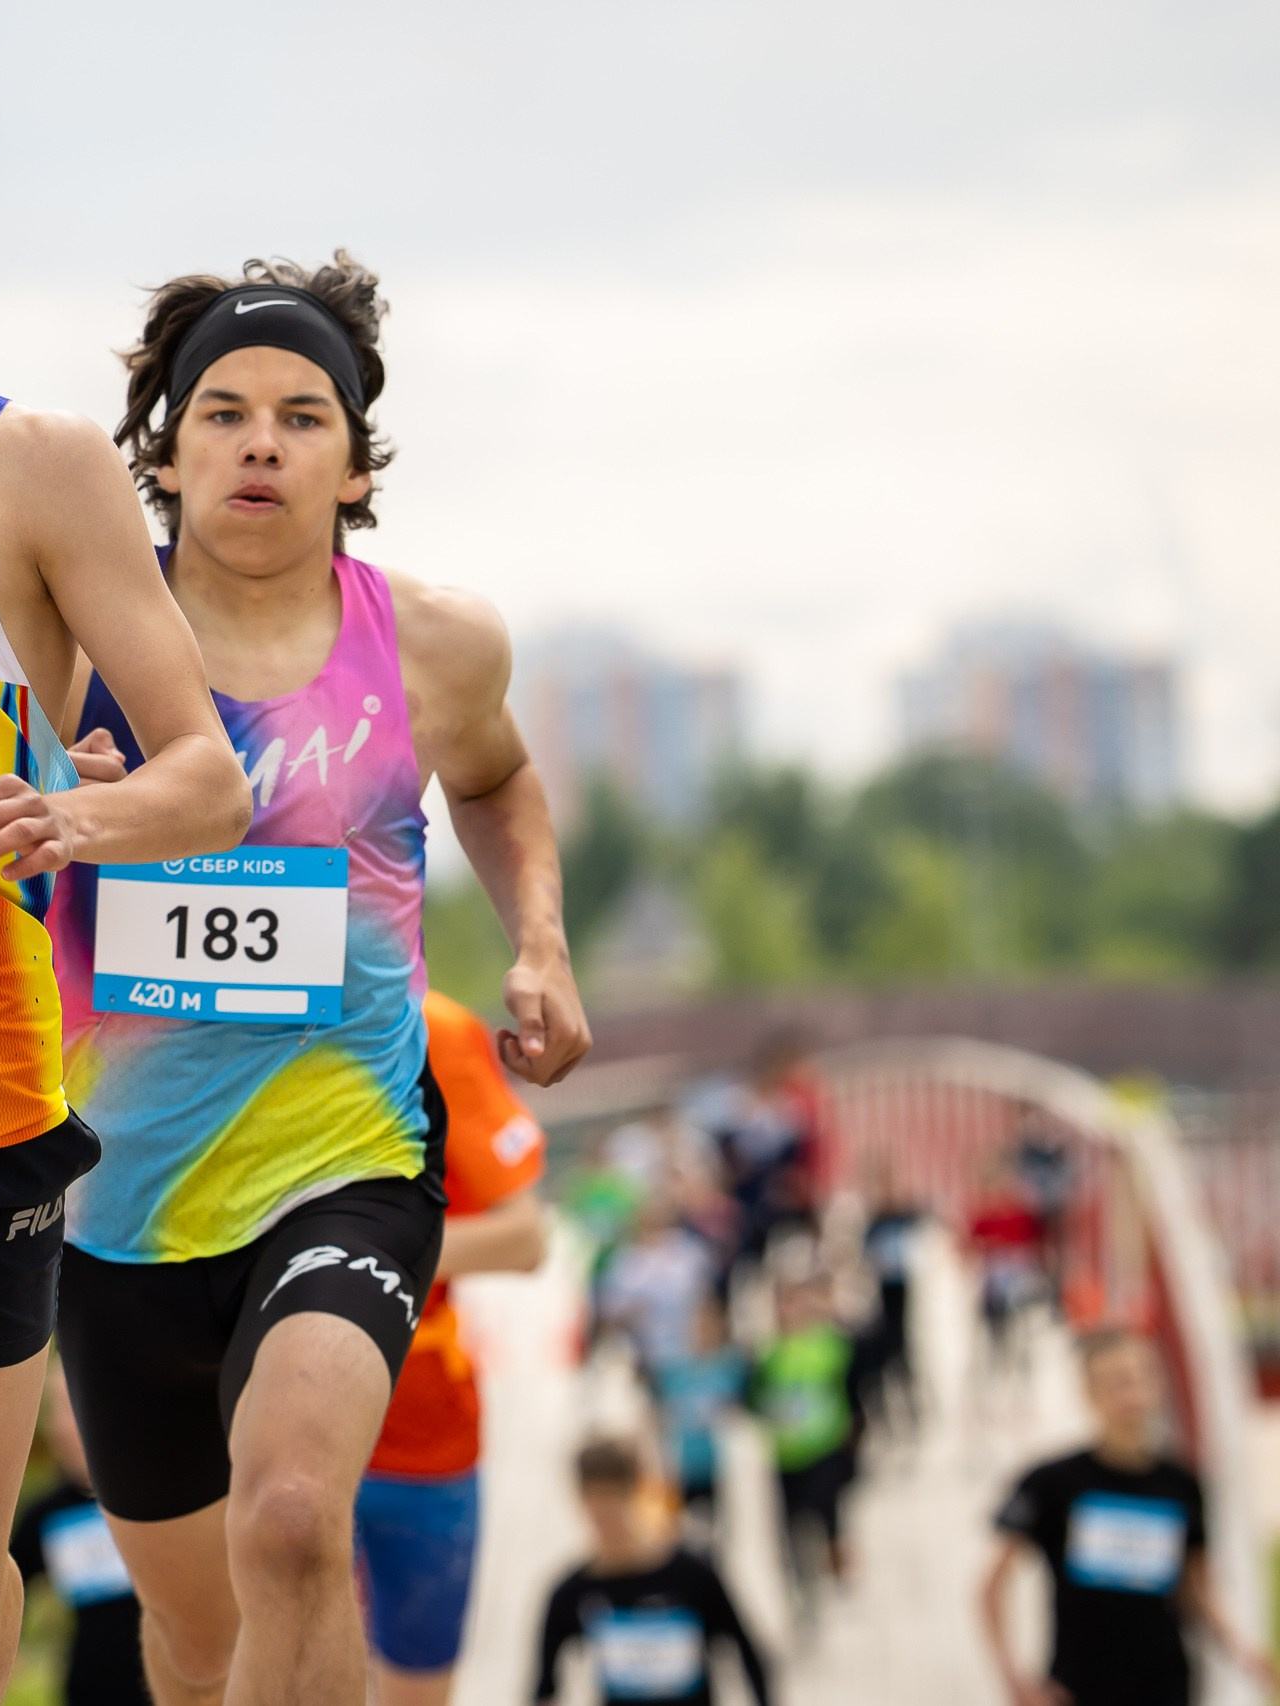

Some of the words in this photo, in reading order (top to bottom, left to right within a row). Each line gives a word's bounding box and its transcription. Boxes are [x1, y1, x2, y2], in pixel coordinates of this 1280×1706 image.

[189, 858, 239, 874] СБЕР
[243, 860, 286, 875] KIDS
[166, 905, 279, 963] 183
[128, 981, 175, 1009] 420
